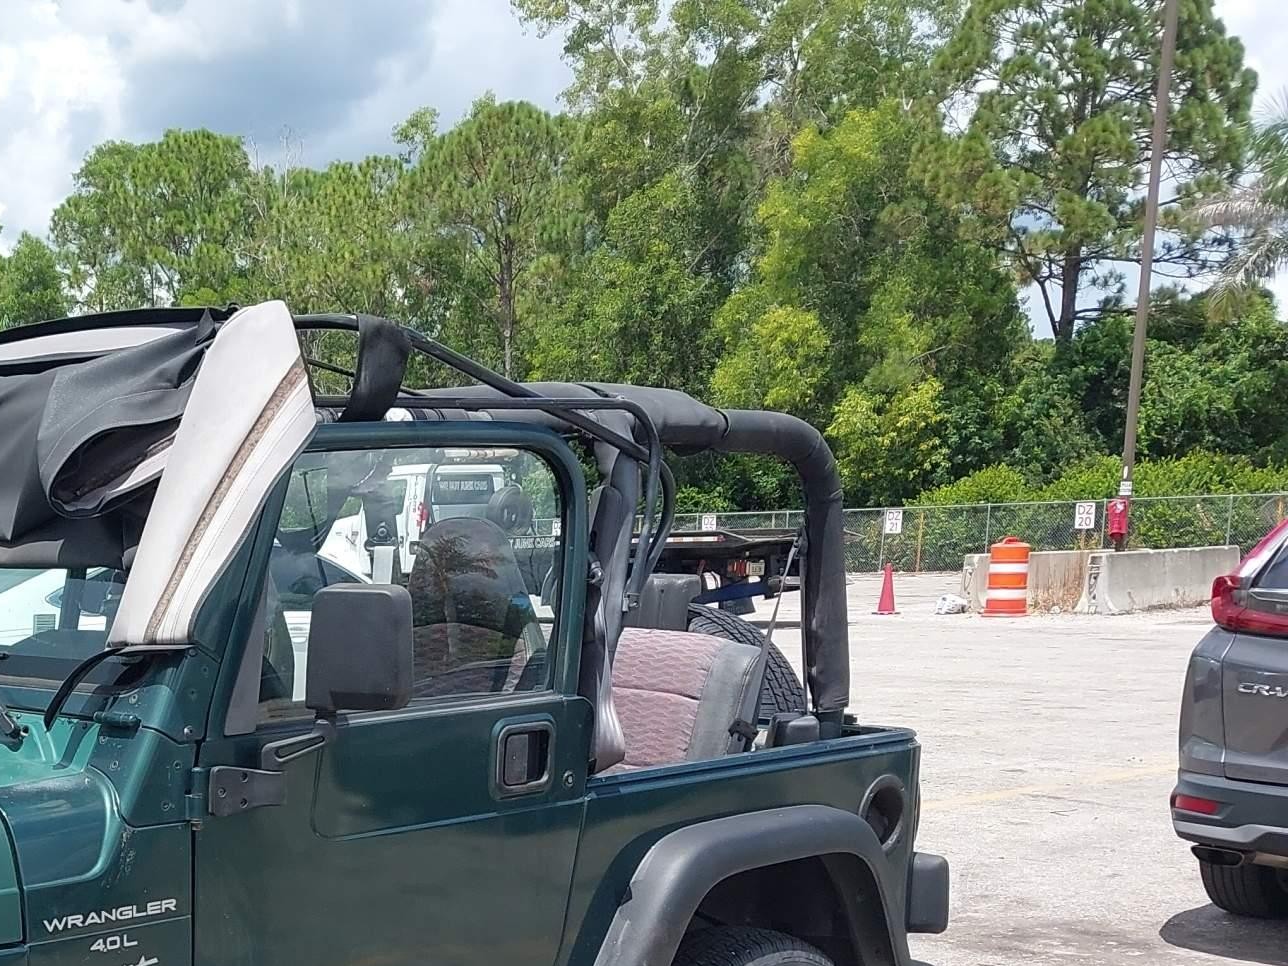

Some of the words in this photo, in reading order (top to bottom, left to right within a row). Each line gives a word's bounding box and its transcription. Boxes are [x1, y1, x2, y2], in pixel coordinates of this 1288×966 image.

[1078, 504, 1093, 516] DZ
[703, 516, 716, 526] DZ
[887, 511, 901, 521] DZ
[1078, 516, 1092, 527] 20
[889, 522, 898, 532] 21
[43, 898, 177, 933] WRANGLER
